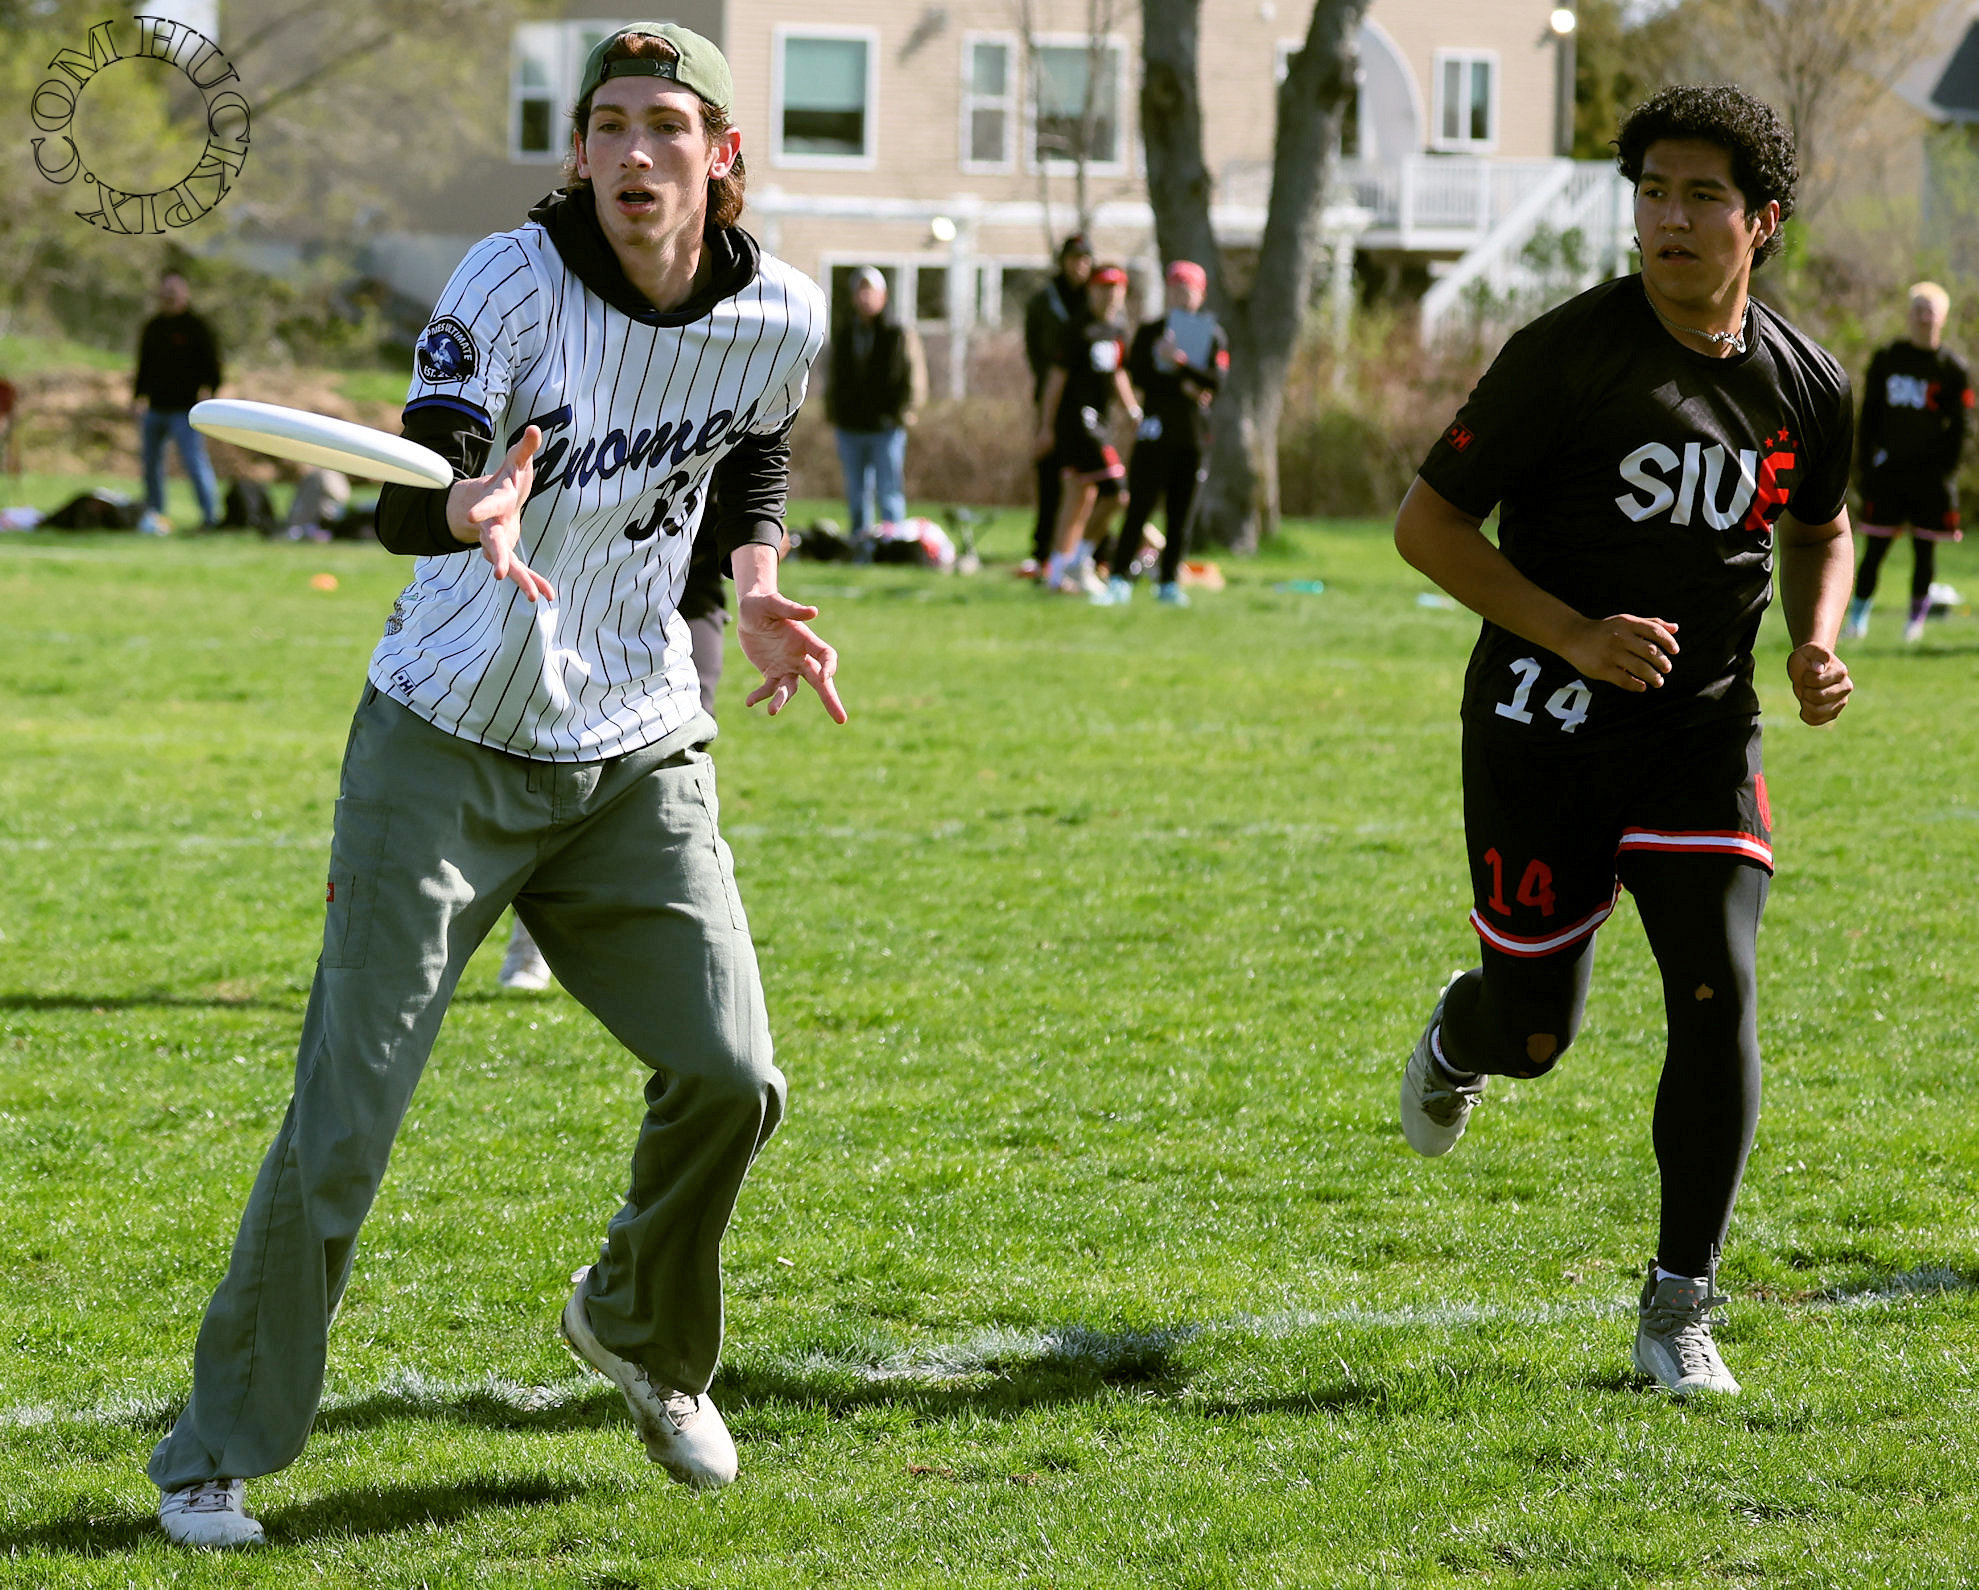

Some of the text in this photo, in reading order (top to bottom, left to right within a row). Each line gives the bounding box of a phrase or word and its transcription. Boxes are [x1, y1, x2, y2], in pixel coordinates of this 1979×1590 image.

[445, 323, 473, 361] ULTIMATE
[1495, 657, 1593, 733] 14
[1484, 847, 1556, 917] 14
